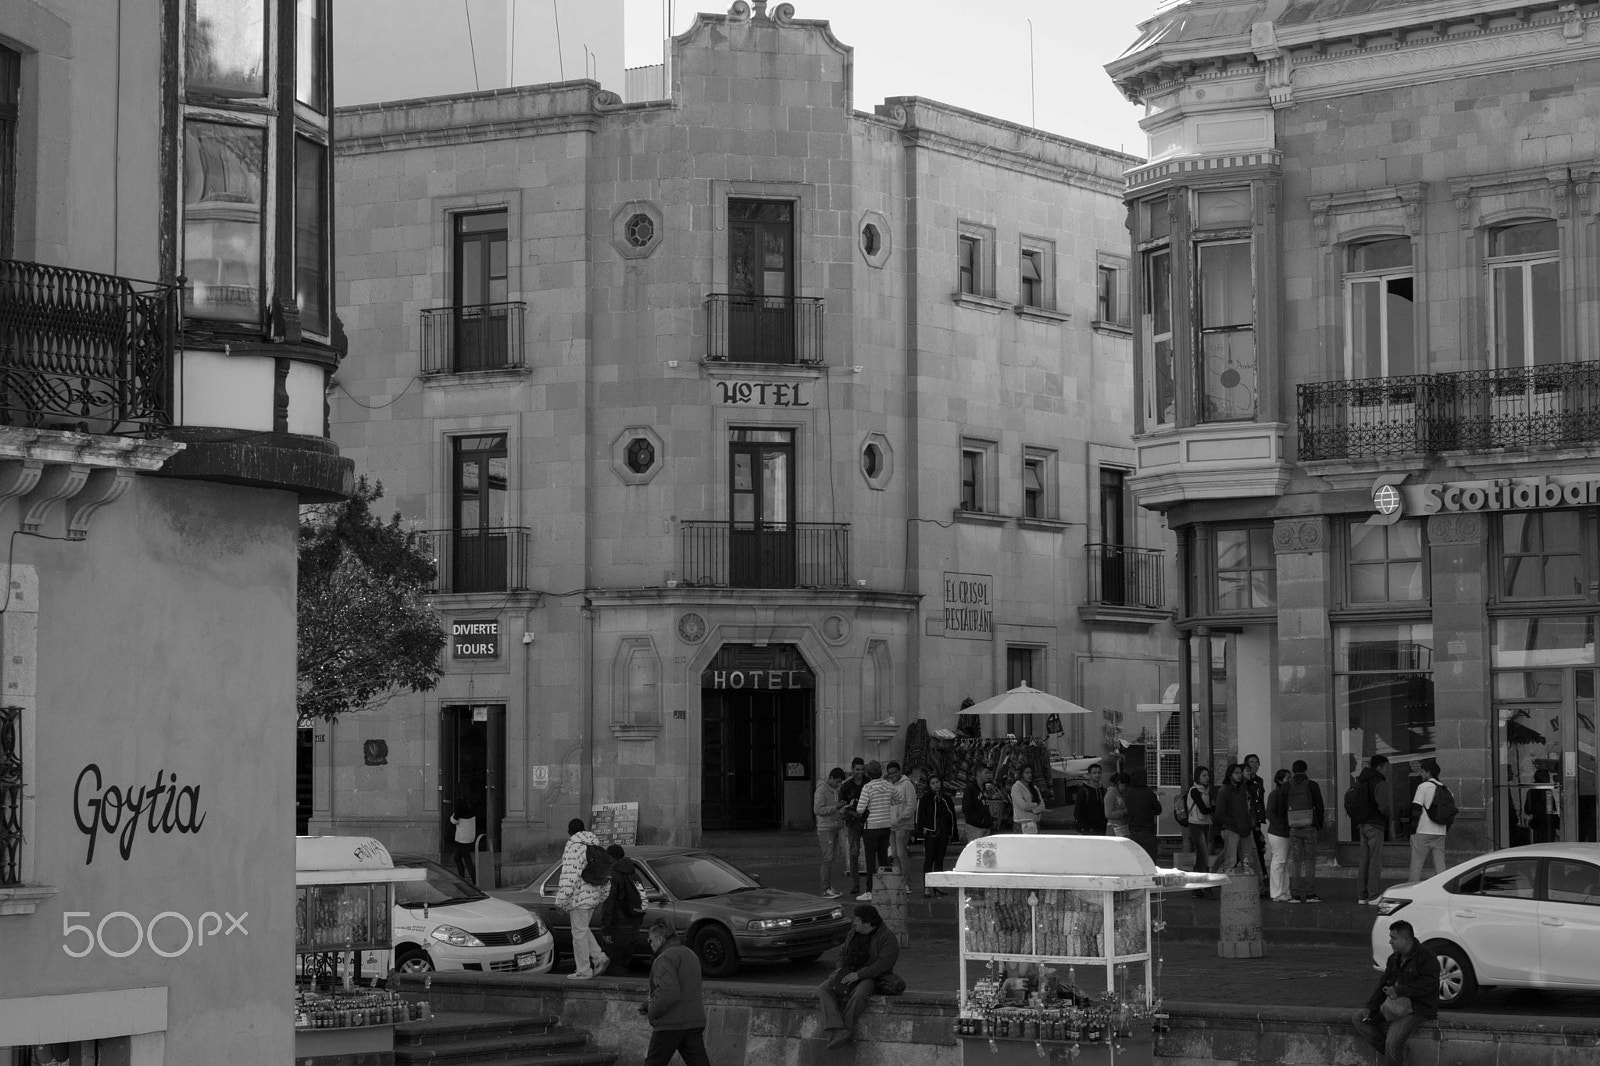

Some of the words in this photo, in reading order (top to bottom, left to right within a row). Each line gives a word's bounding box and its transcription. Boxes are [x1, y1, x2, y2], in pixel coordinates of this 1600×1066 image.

[716, 381, 810, 407] HOTEL
[945, 578, 958, 603] EL
[959, 580, 990, 605] CRISOL
[453, 623, 498, 636] DIVIERTE
[945, 606, 993, 633] RESTAURANT
[455, 643, 495, 655] TOURS
[713, 670, 801, 690] HOTEL
[73, 763, 207, 866] Goytia
